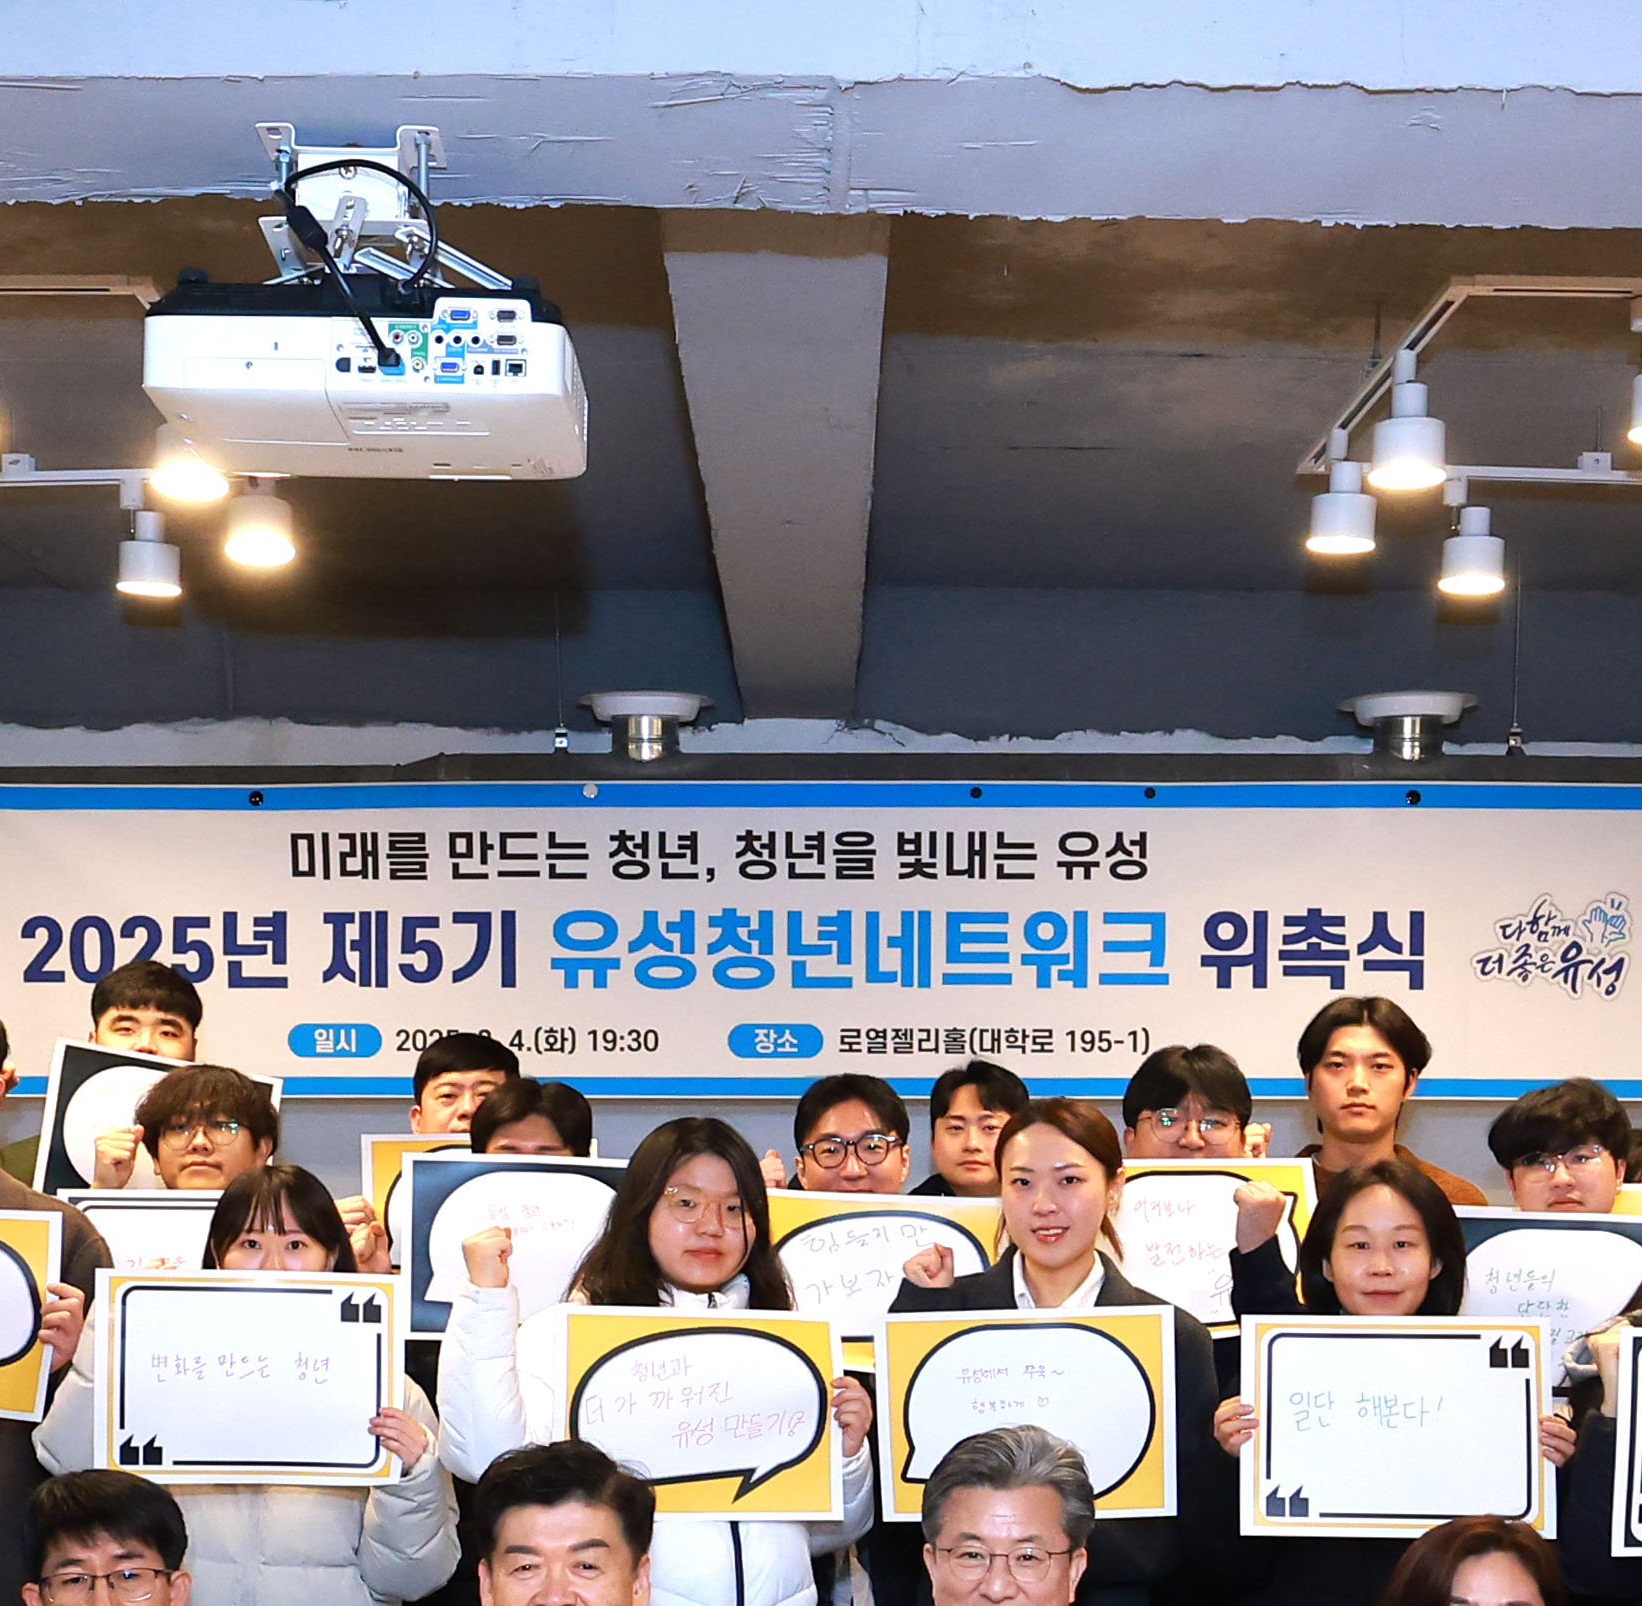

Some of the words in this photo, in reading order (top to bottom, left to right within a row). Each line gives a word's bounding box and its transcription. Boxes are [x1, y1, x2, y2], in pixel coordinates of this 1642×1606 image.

[290, 831, 429, 880] 미래를
[448, 831, 589, 880] 만드는
[608, 829, 715, 882] 청년,
[734, 829, 877, 880] 청년을
[897, 831, 1038, 880] 빛내는
[1057, 831, 1149, 880] 유성
[1499, 899, 1571, 942] 다함께
[21, 910, 289, 989] 2025년
[322, 910, 517, 988] 제5기
[551, 908, 1170, 990] 유성청년네트워크
[1200, 908, 1425, 990] 위촉식
[1476, 953, 1504, 976] 더
[1506, 943, 1556, 983] 좋은
[1551, 940, 1625, 996] 유성
[313, 1028, 357, 1053] 일시
[587, 1029, 659, 1052] 19:30
[753, 1028, 799, 1053] 장소
[838, 1026, 1054, 1055] 로열젤리홀(대학로
[1065, 1026, 1150, 1055] 195-1)
[151, 1353, 208, 1383] 변화를
[218, 1353, 271, 1380] 만드는
[294, 1352, 330, 1385] 청년
[1289, 1391, 1335, 1432] 일단
[1355, 1392, 1444, 1429] 해본다!
[672, 1416, 714, 1449] 유성
